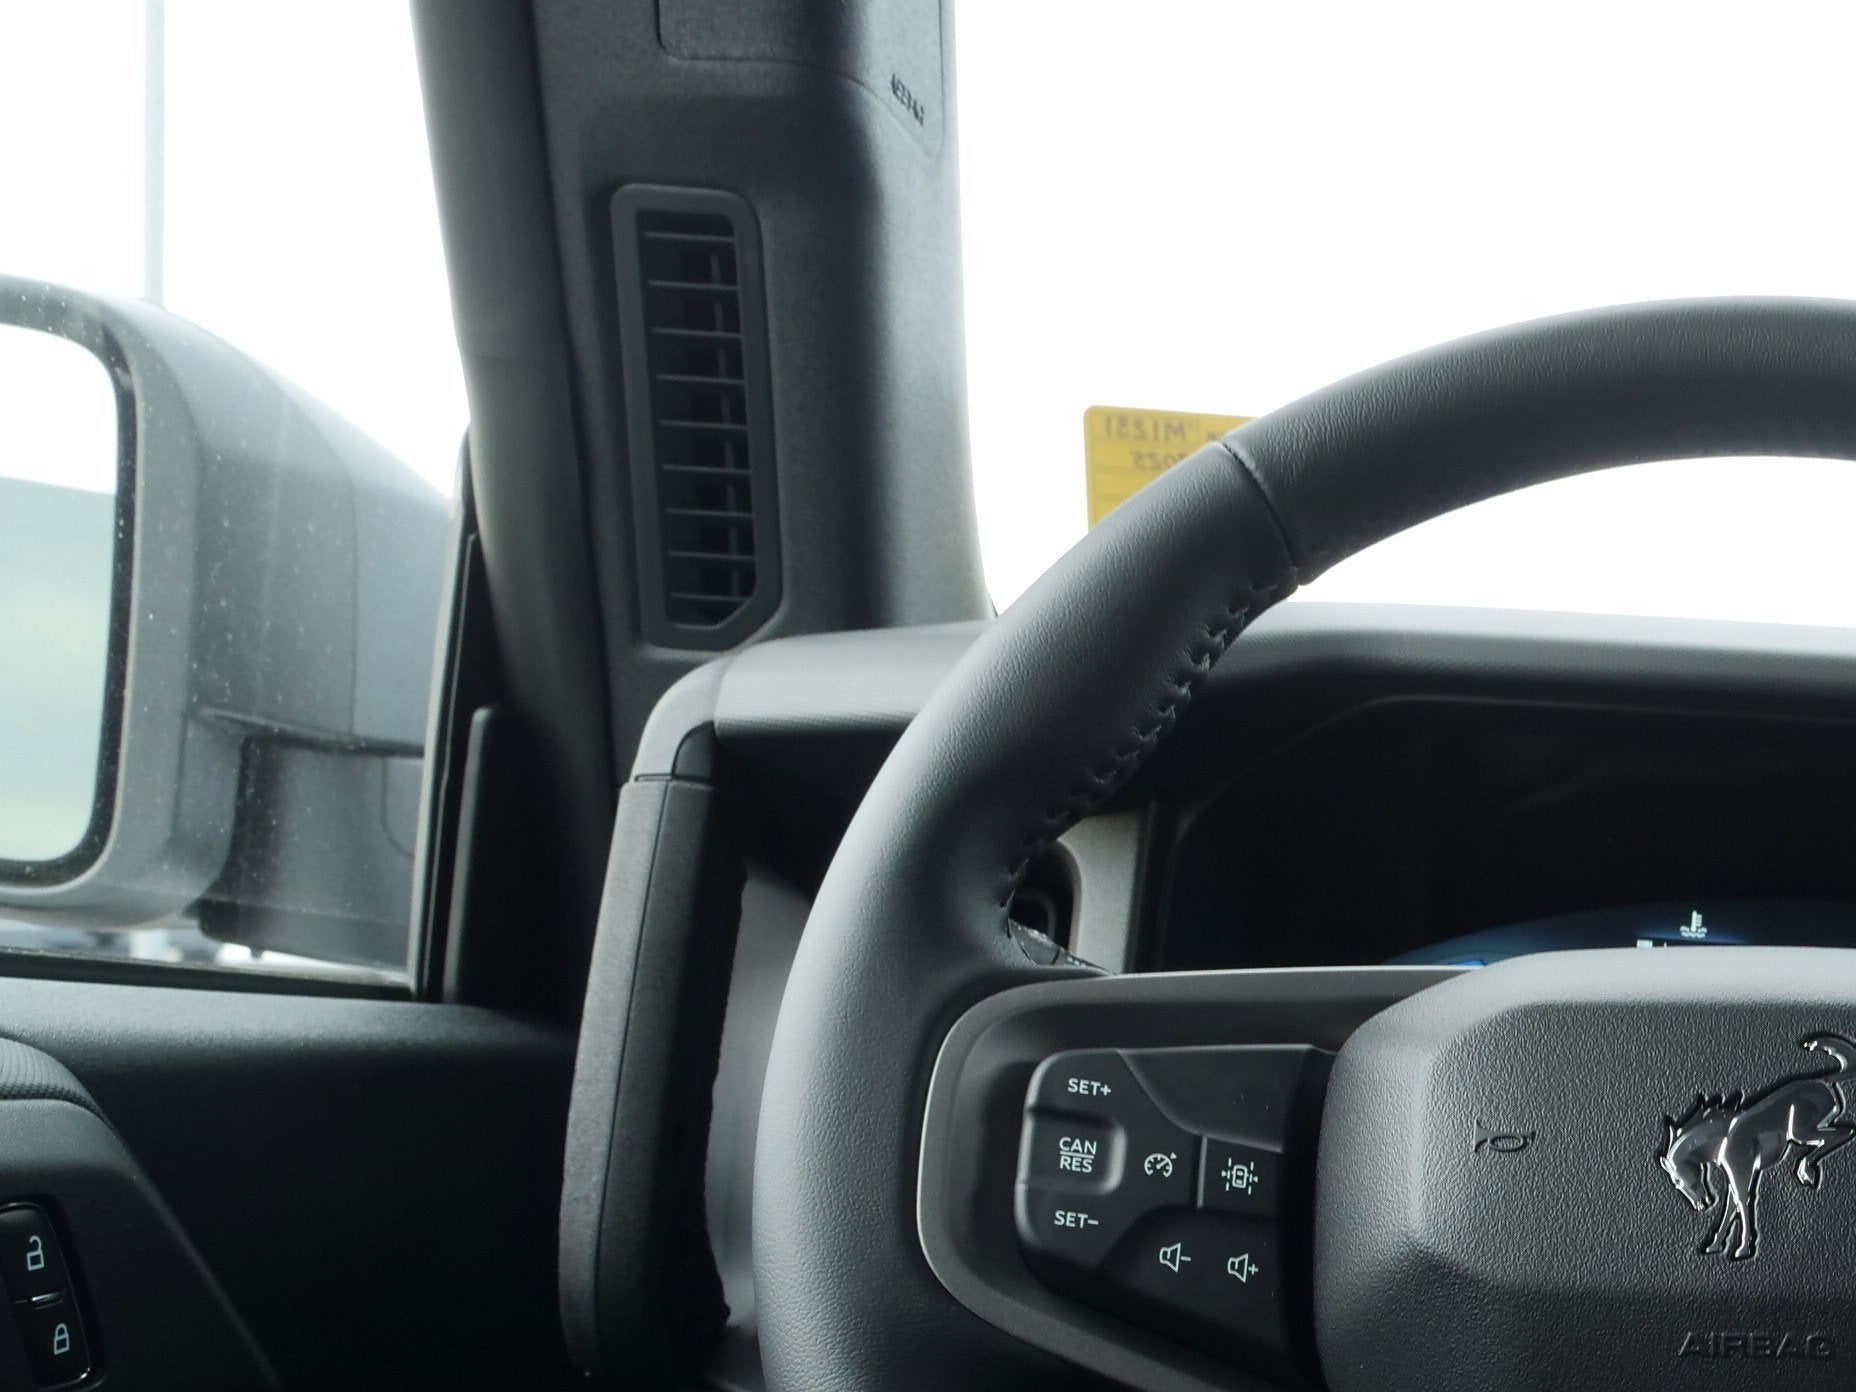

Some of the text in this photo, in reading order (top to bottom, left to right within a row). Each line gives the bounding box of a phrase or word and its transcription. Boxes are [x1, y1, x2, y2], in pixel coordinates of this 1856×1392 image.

[1067, 1077, 1112, 1097] SET+
[1058, 1135, 1098, 1155] CAN
[1059, 1156, 1093, 1174] RES
[1677, 1331, 1836, 1359] AIRBAG
